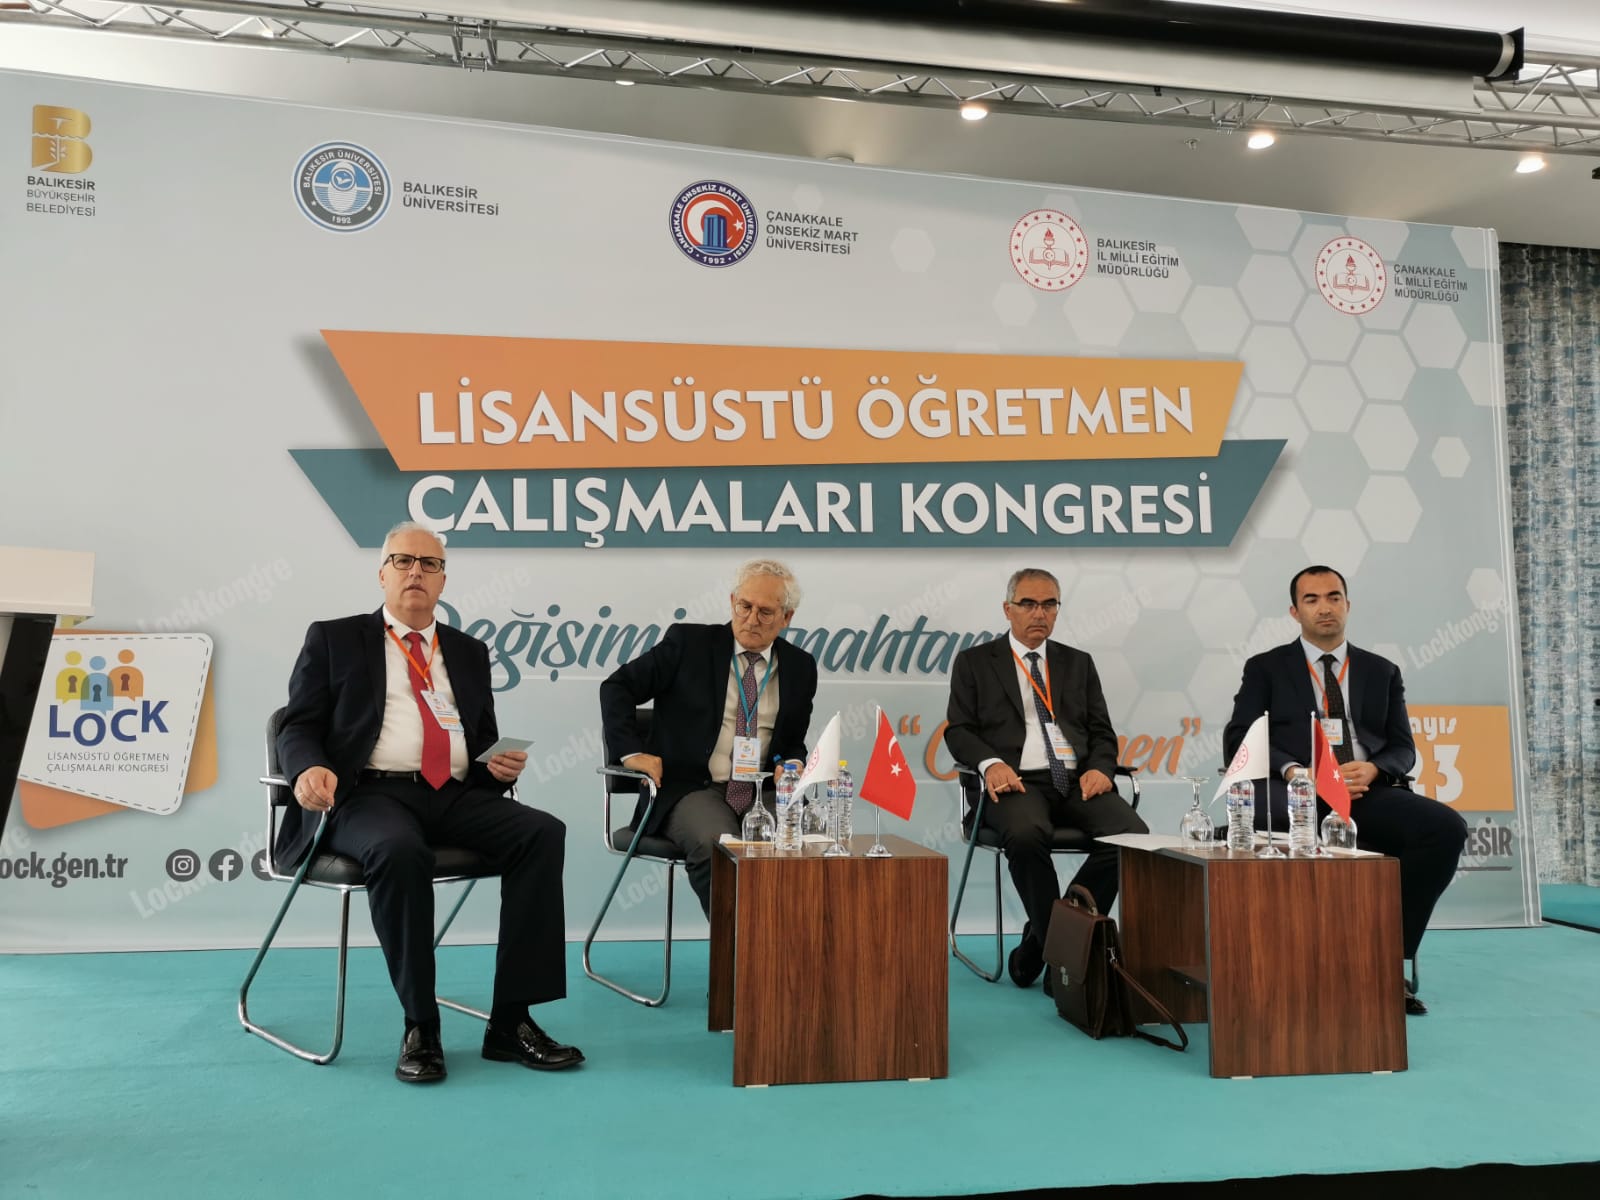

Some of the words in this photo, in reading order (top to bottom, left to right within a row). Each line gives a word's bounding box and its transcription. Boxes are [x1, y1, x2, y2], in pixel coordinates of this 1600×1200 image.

[27, 176, 96, 191] BALIKESİR
[403, 182, 478, 200] BALIKESİR
[26, 188, 96, 204] BÜYÜKŞEHİR
[26, 202, 96, 217] BELEDİYESİ
[402, 195, 500, 216] ÜNİVERSİTESİ
[766, 210, 844, 228] ÇANAKKALE
[766, 224, 821, 239] ONSEKİZ
[824, 229, 859, 242] MART
[766, 235, 851, 255] ÜNİVERSİTESİ
[1097, 238, 1156, 252] BALIKESİR
[702, 255, 727, 265] 1992
[1097, 249, 1107, 261] İL
[1142, 254, 1179, 267] EĞİTİM
[1097, 263, 1169, 279] MÜDÜRLÜĞÜ
[1393, 263, 1456, 278] ÇANAKKALE
[1394, 273, 1403, 286] İL
[1434, 278, 1468, 291] EĞİTİM
[1394, 287, 1459, 303] MÜDÜRLÜĞÜ
[418, 375, 833, 445] LİSANSÜSTÜ
[857, 373, 1193, 439] ÖĞRETMEN
[407, 474, 874, 549] ÇALIŞMALARI
[901, 471, 1213, 536] KONGRESİ
[49, 700, 169, 746] LOCK
[47, 752, 110, 761] LİSANSÜSTÜ
[113, 752, 170, 761] ÖĞRETMEN
[46, 763, 115, 773] ÇALIŞMALARI
[117, 763, 169, 773] KONGRESİ
[1463, 817, 1512, 857] ESİR
